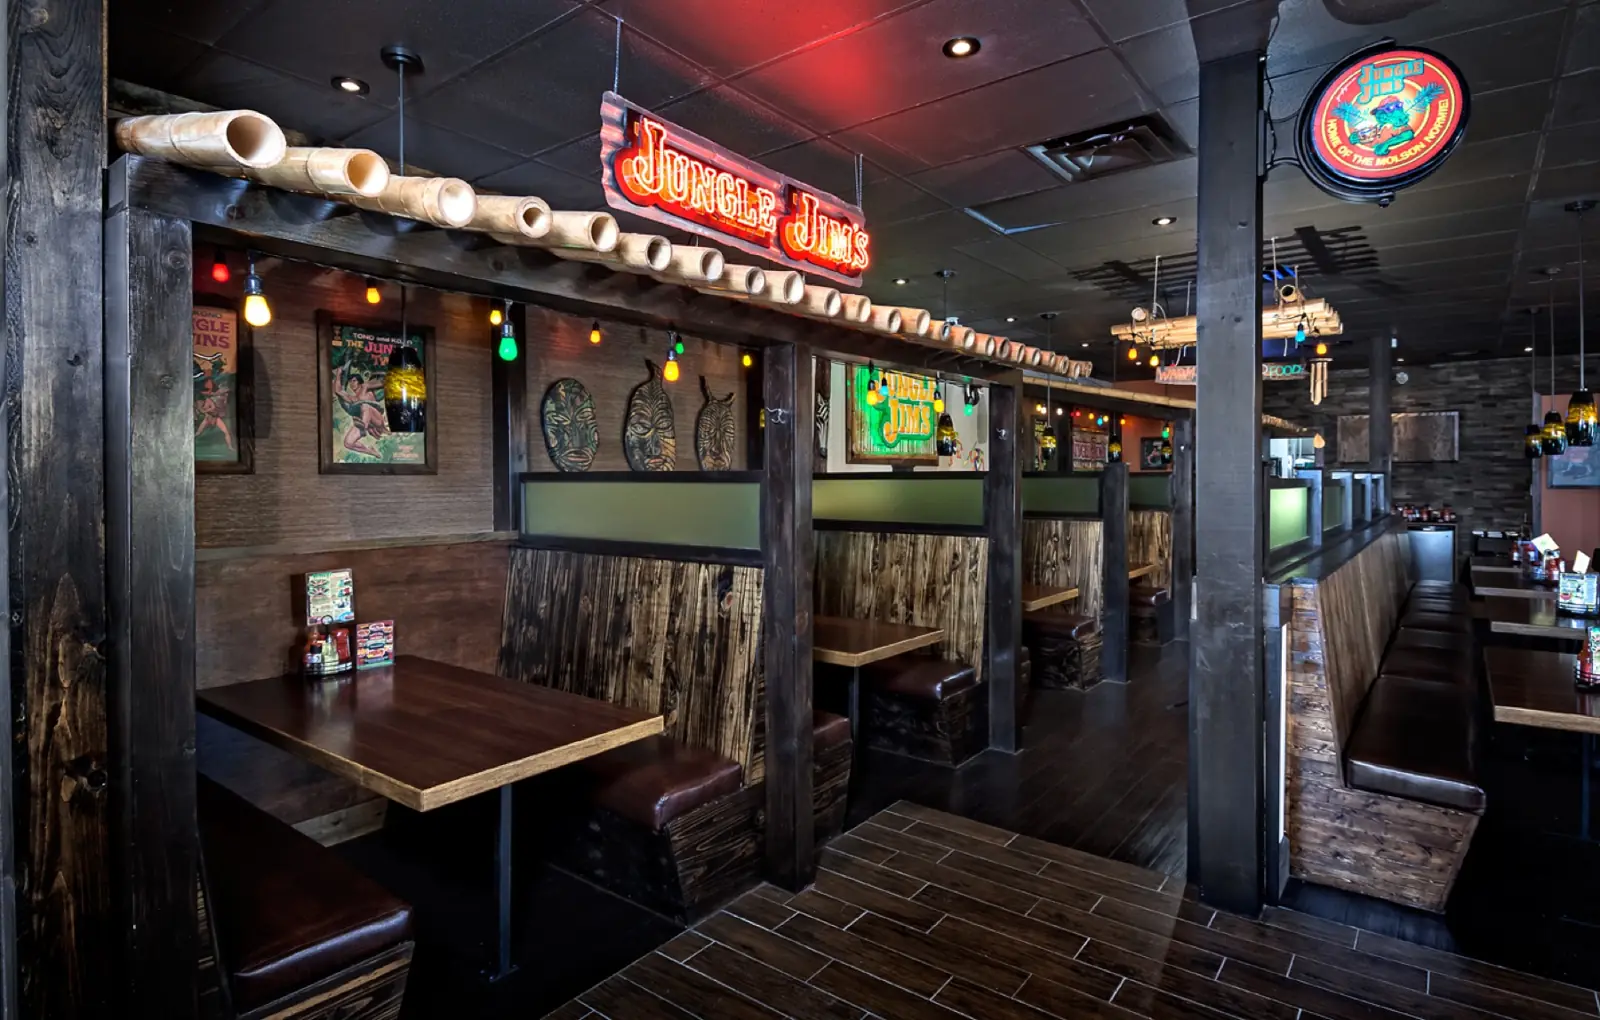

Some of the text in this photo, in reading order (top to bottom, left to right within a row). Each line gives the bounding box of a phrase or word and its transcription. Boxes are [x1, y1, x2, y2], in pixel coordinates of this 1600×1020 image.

[1359, 61, 1422, 85] JUNGLE
[1326, 118, 1342, 148] HOME
[1337, 145, 1353, 158] OF
[1351, 153, 1374, 166] THE
[1375, 141, 1426, 167] MOLSON
[626, 117, 778, 232] JUNGLE
[193, 318, 231, 334] GLE
[193, 333, 230, 349] INS
[346, 339, 364, 349] THE
[364, 341, 394, 355] JUN
